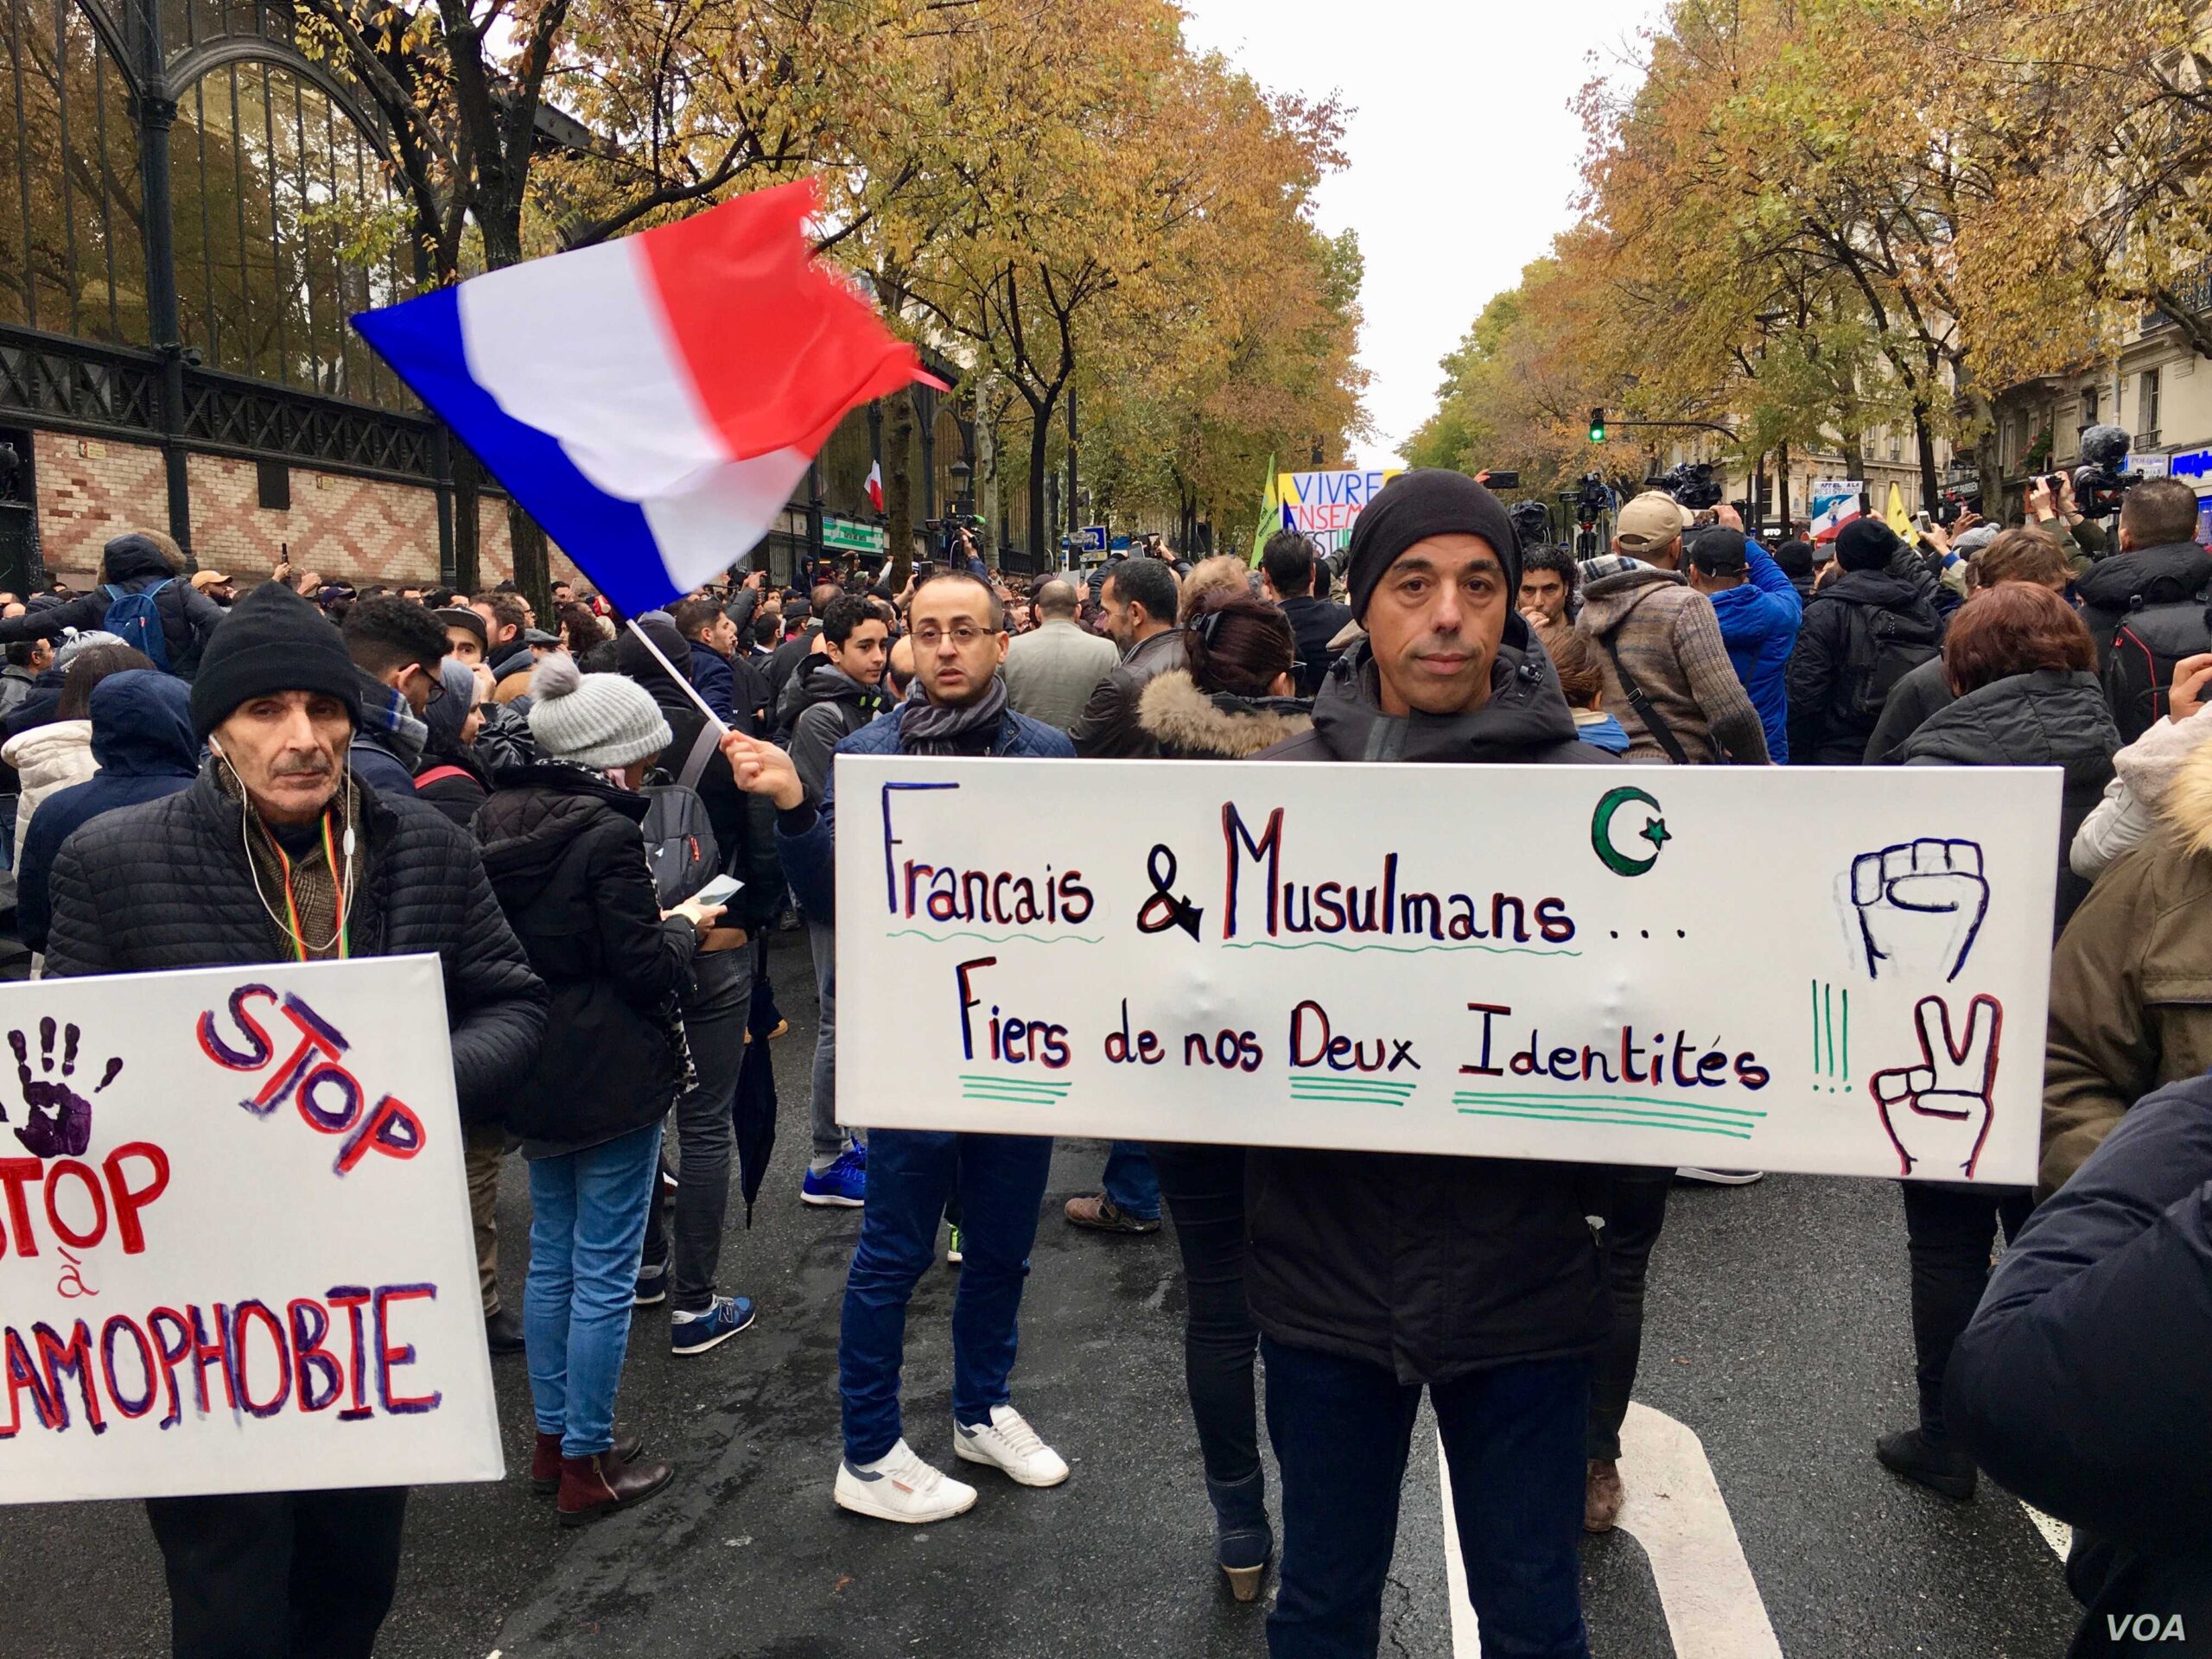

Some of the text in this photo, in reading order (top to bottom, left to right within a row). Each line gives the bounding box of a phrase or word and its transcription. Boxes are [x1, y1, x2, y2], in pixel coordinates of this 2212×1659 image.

[1289, 503, 1363, 530] NSEM
[1293, 473, 1383, 505] VIVRE
[881, 781, 1094, 924] Francais
[1136, 843, 1205, 944] &
[1222, 801, 1576, 944] Musulmans
[196, 982, 427, 1179] STOP
[956, 956, 1071, 1070] Fiers
[1104, 997, 1165, 1065] de
[1184, 1028, 1263, 1073] nos
[1289, 999, 1421, 1071] Deux
[1459, 1003, 1770, 1090] Identités
[0, 1141, 170, 1258] TOP
[0, 1282, 442, 1439] AMOPHOBIE
